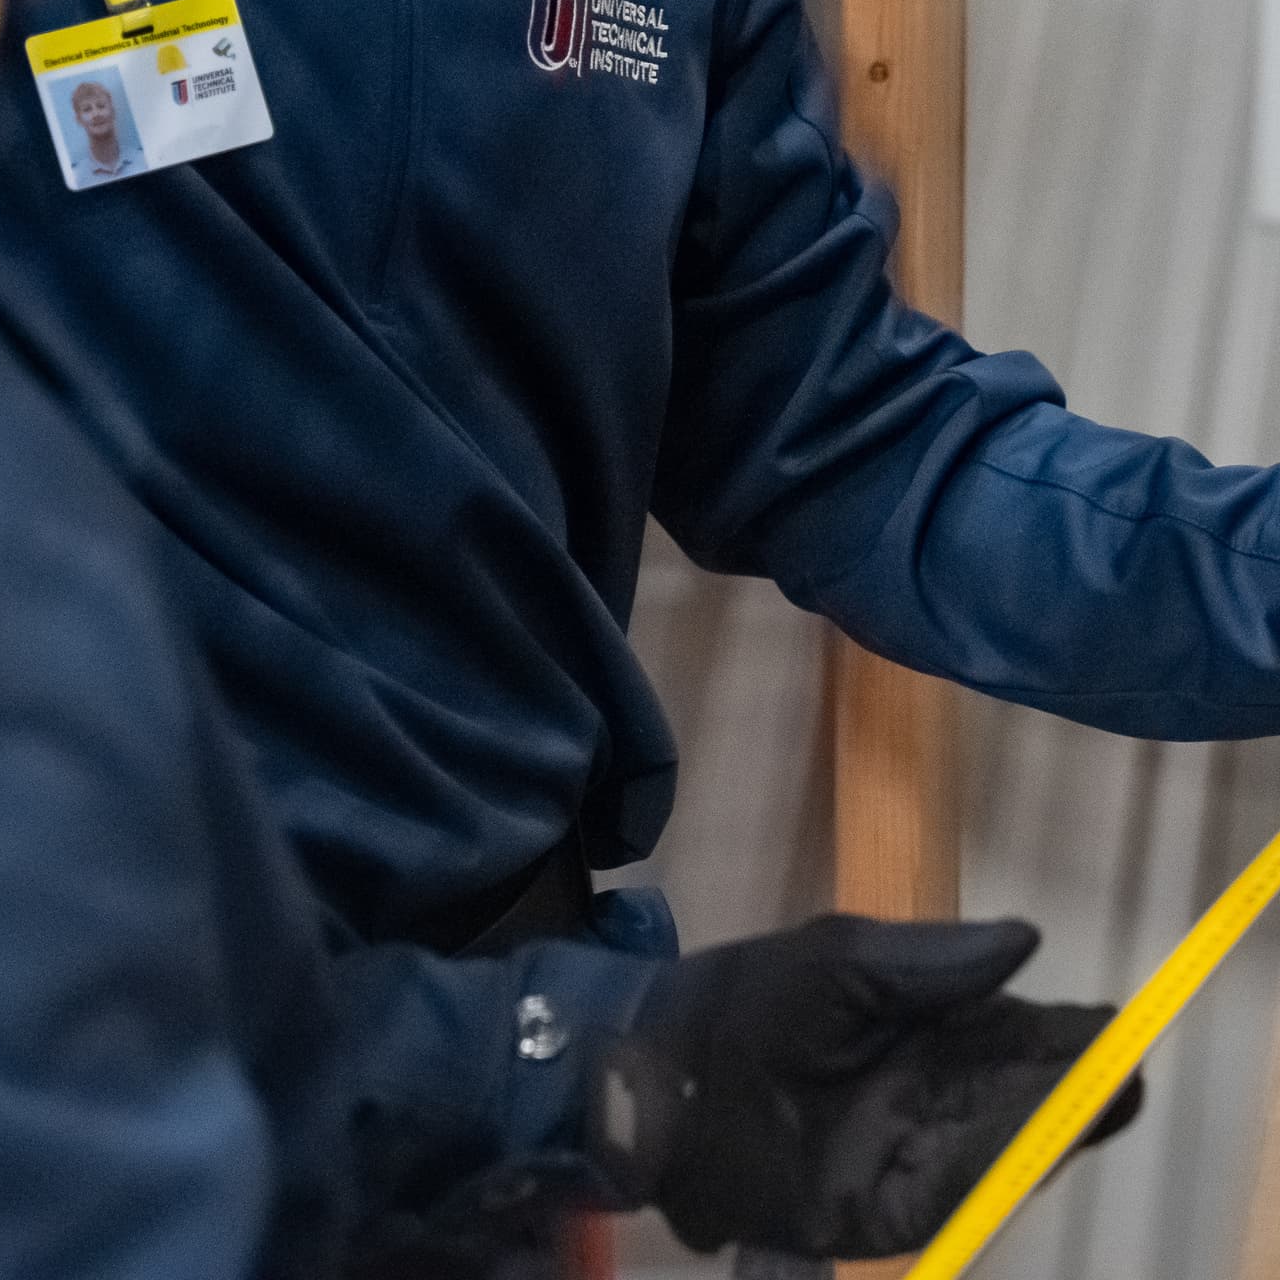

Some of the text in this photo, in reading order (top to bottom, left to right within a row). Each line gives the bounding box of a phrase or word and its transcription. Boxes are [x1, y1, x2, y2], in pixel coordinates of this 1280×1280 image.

[43, 51, 83, 68] Electrical
[84, 41, 131, 58] Electronics
[141, 28, 180, 42] Industrial
[182, 16, 229, 32] Technology
[591, 20, 669, 58] TECHNICAL
[192, 67, 234, 83] UNIVERSAL
[589, 48, 660, 85] INSTITUTE
[193, 76, 235, 92] TECHNICAL
[194, 84, 236, 100] INSTITUTE
